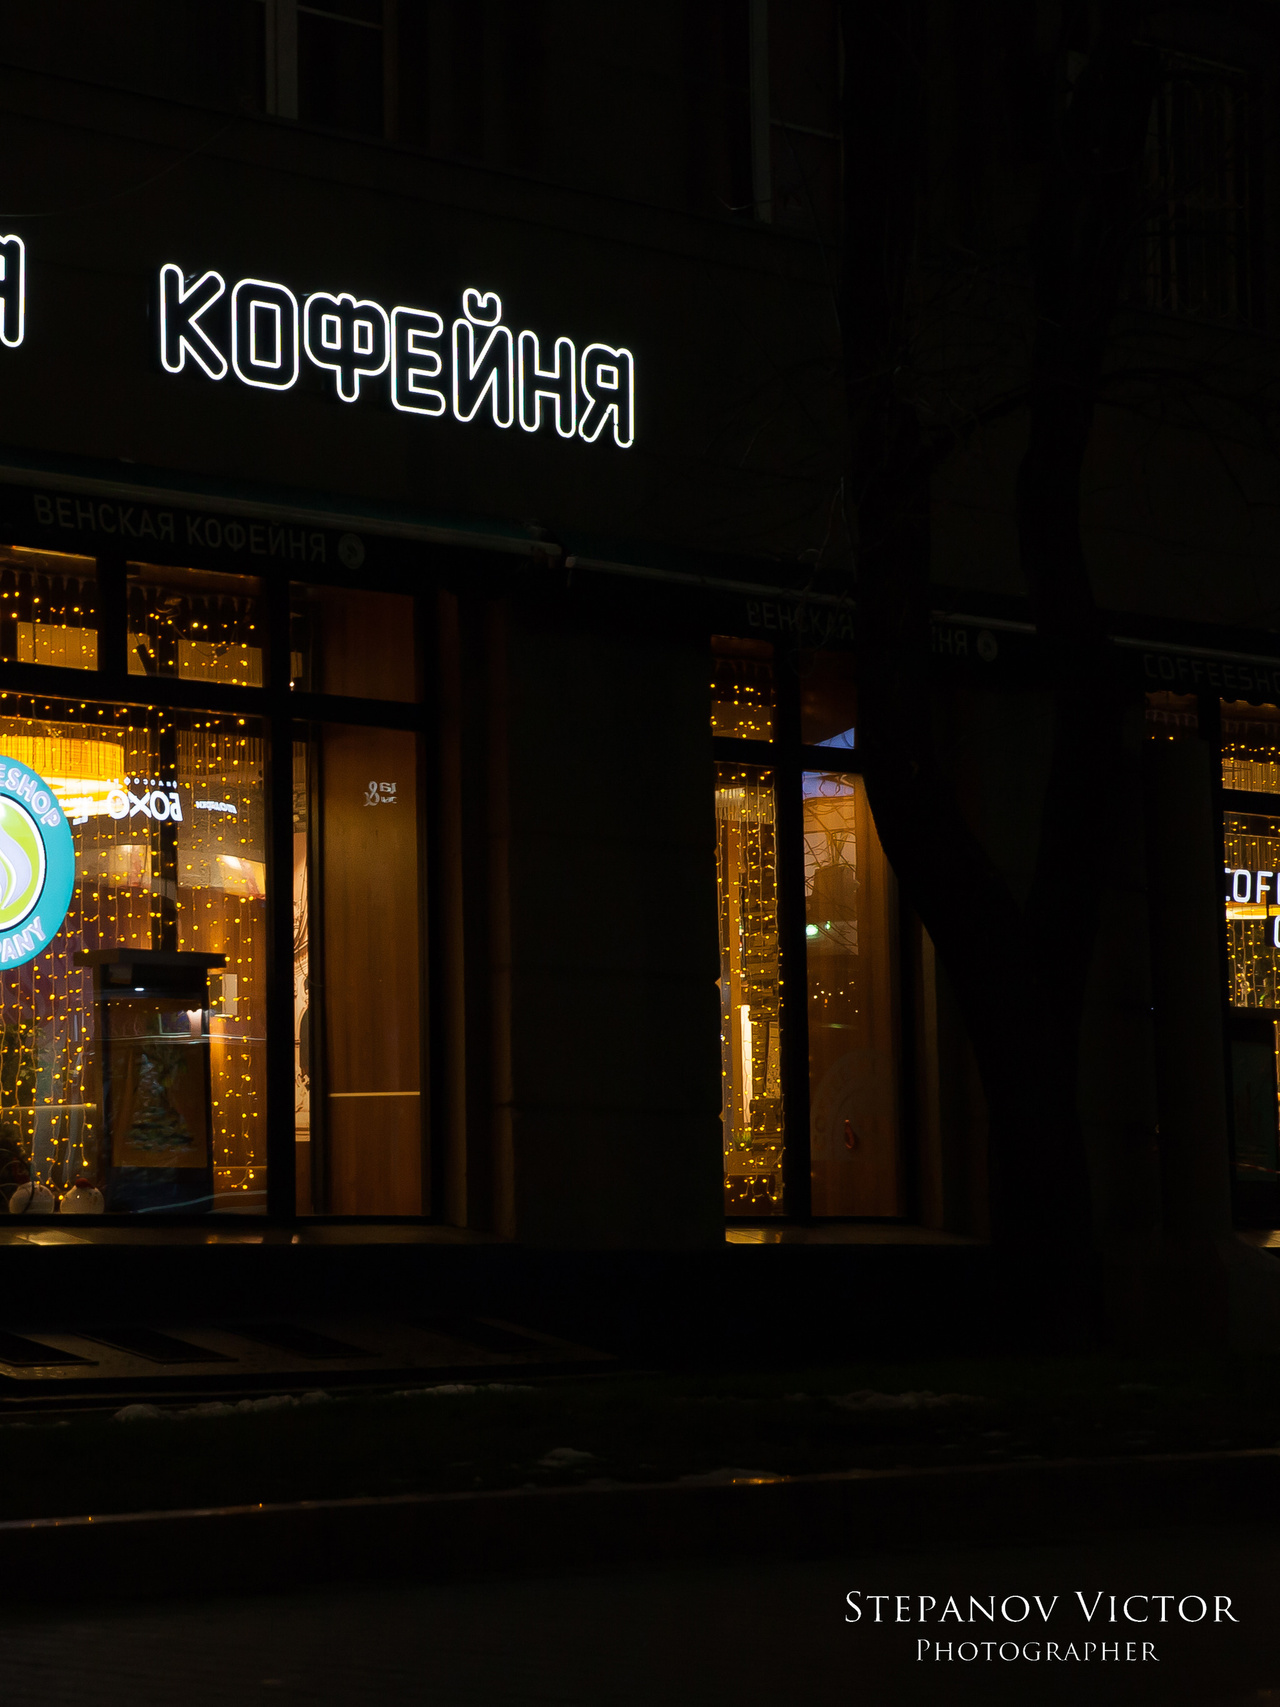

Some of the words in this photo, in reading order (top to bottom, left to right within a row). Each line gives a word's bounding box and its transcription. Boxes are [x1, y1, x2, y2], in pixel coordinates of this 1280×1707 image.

[159, 263, 635, 449] КОФЕЙНЯ
[33, 493, 176, 543] ВЕНСКАЯ
[185, 513, 327, 565] КОФЕЙНЯ
